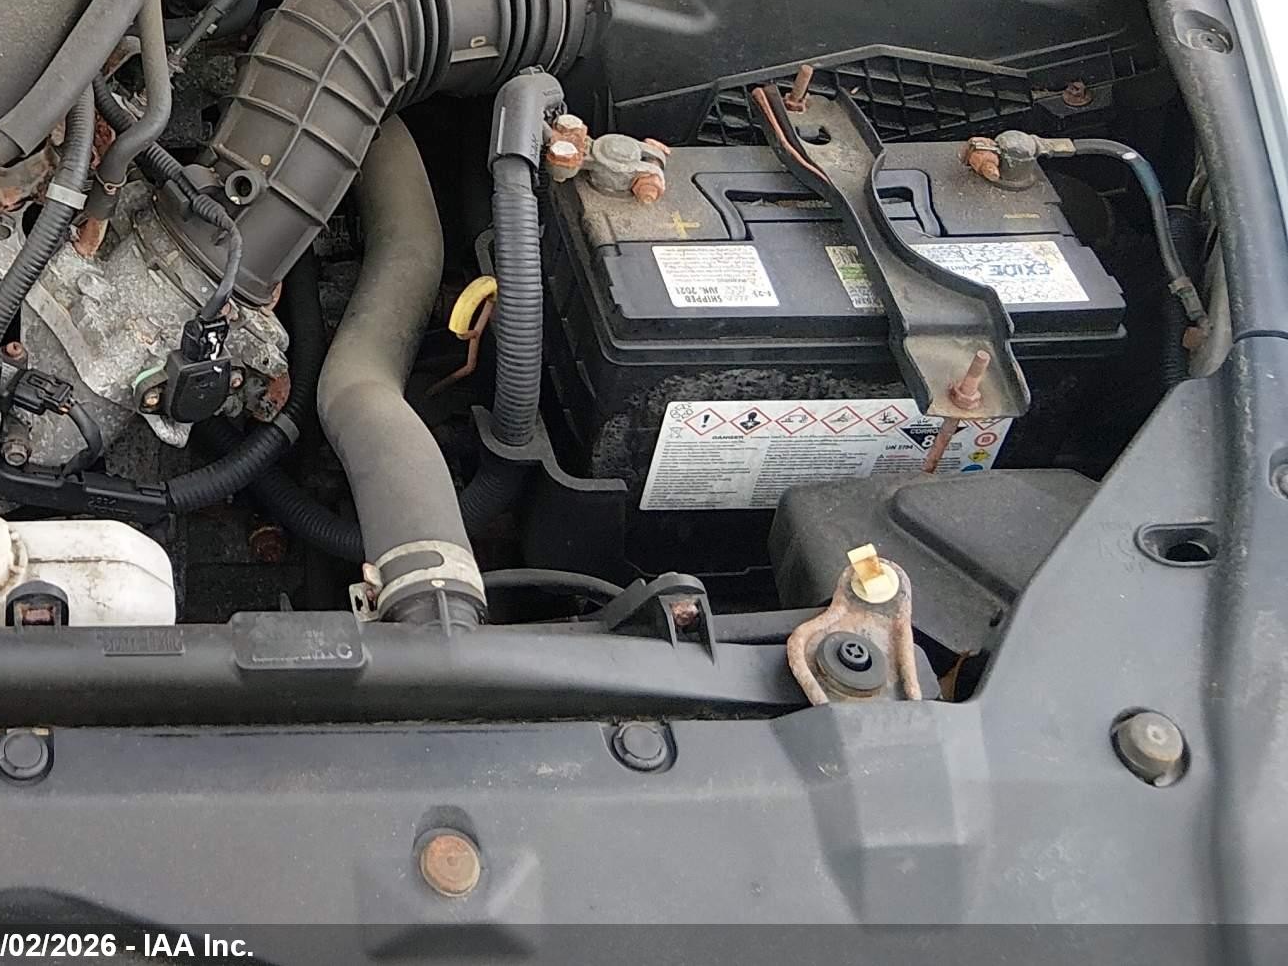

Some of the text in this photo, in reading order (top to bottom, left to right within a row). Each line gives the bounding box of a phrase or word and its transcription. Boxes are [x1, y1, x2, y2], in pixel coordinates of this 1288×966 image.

[990, 261, 1050, 276] EXIDE
[675, 286, 719, 295] JUN. 2021
[685, 294, 723, 303] SHIPPED
[922, 435, 935, 448] 8
